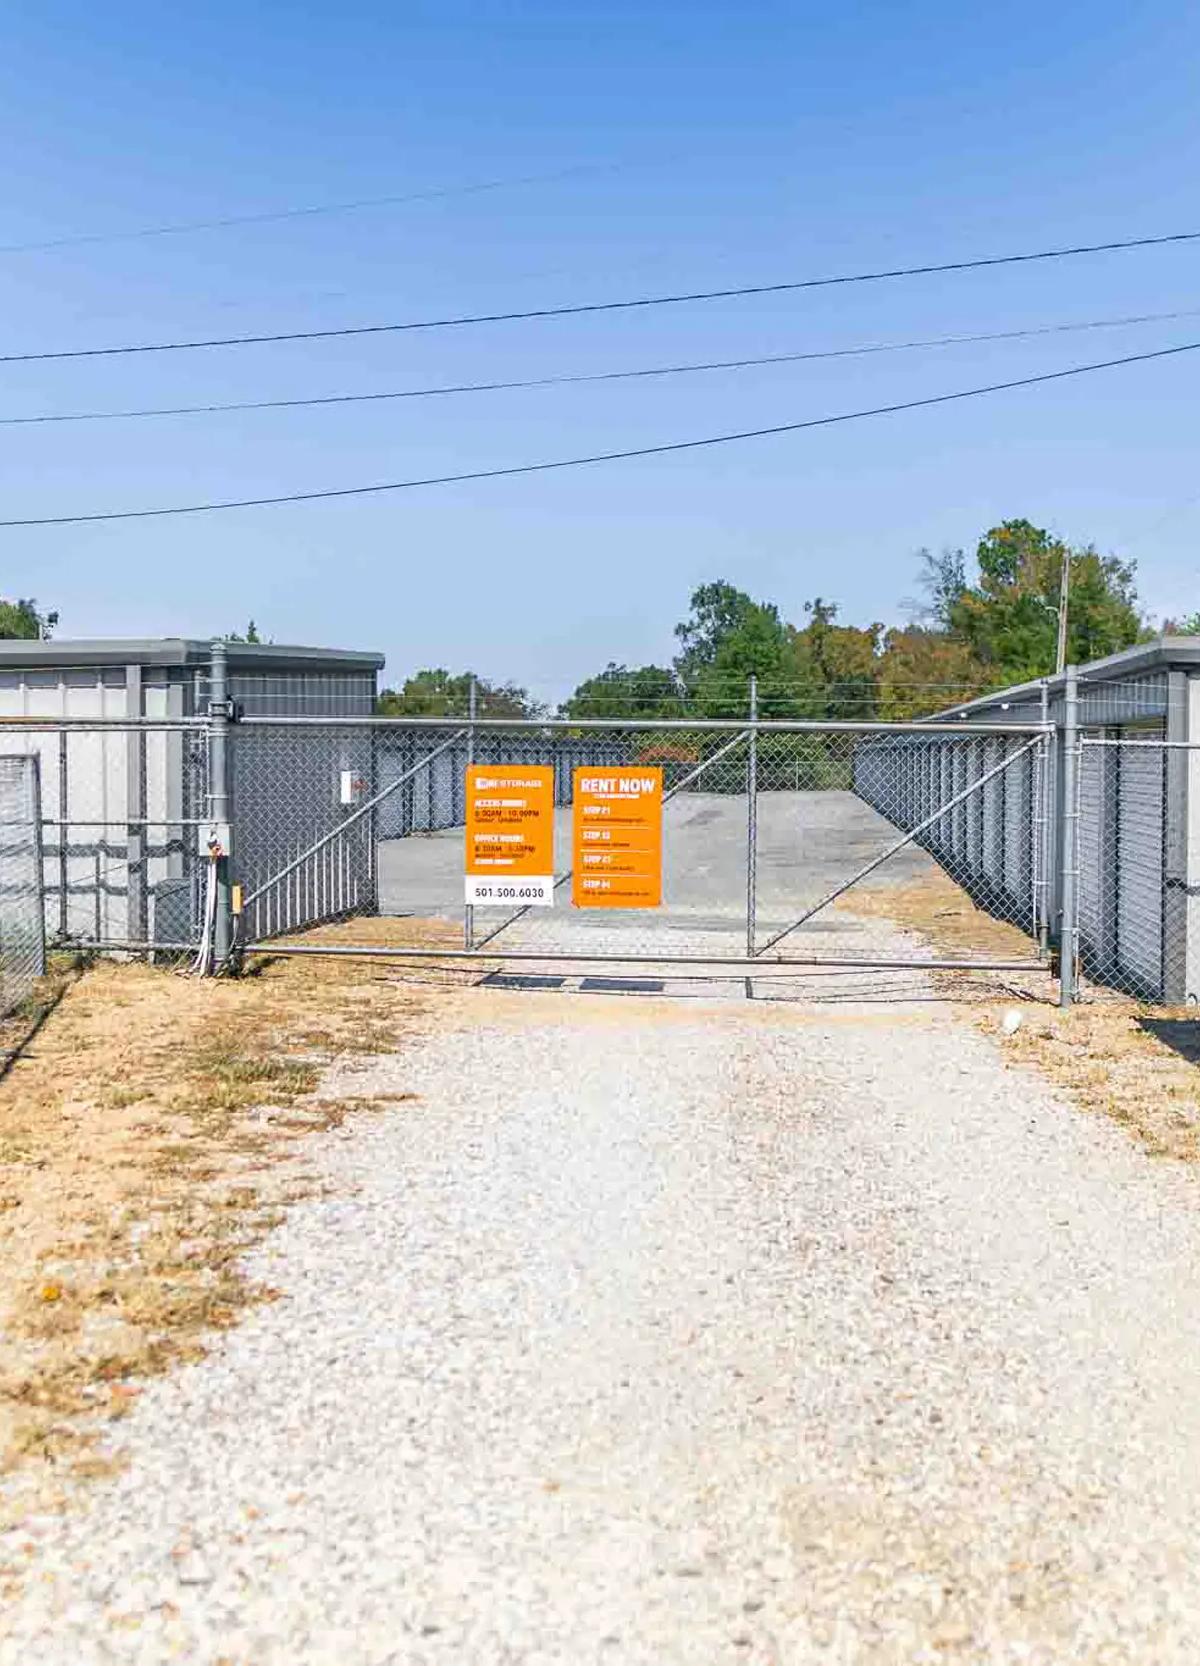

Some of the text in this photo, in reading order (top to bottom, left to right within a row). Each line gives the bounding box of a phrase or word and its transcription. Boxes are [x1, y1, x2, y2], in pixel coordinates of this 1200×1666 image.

[581, 778, 656, 793] RENT NOW
[475, 887, 544, 898] 501.500.6030
